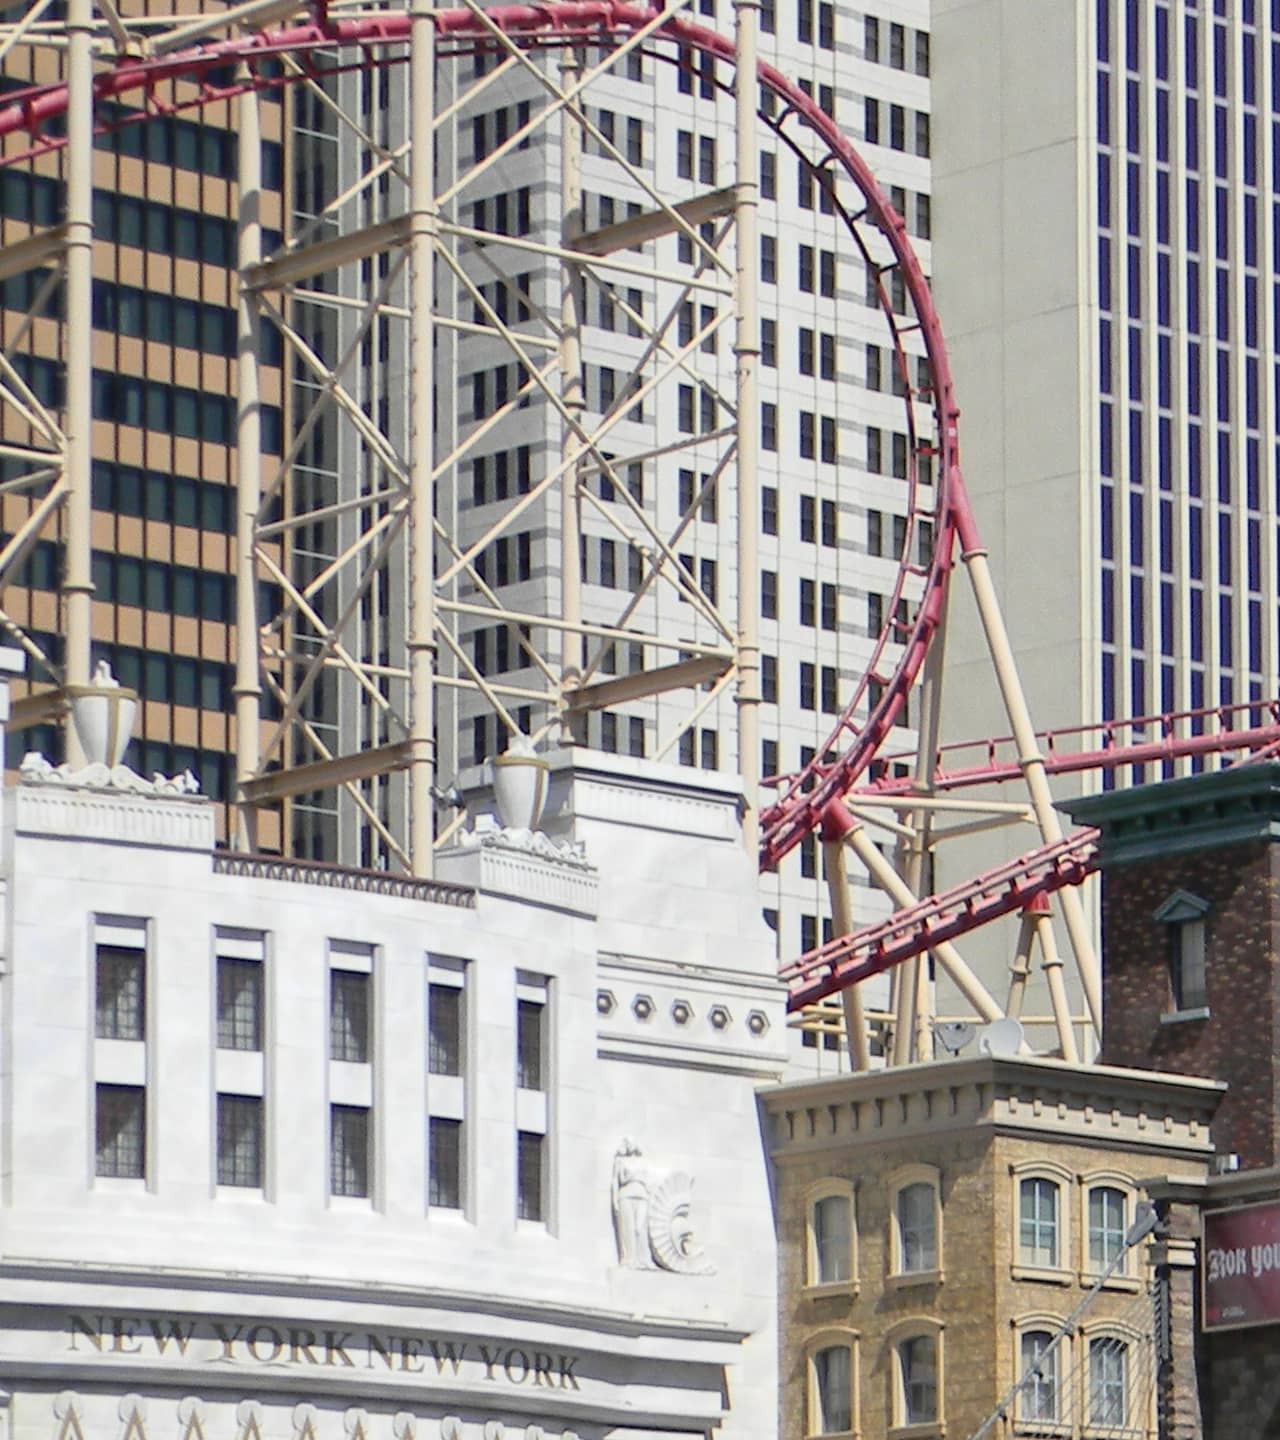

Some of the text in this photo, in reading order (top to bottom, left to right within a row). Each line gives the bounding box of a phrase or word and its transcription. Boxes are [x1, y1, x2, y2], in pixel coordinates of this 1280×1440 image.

[67, 1314, 582, 1391] NEW YORK NEW YORK
